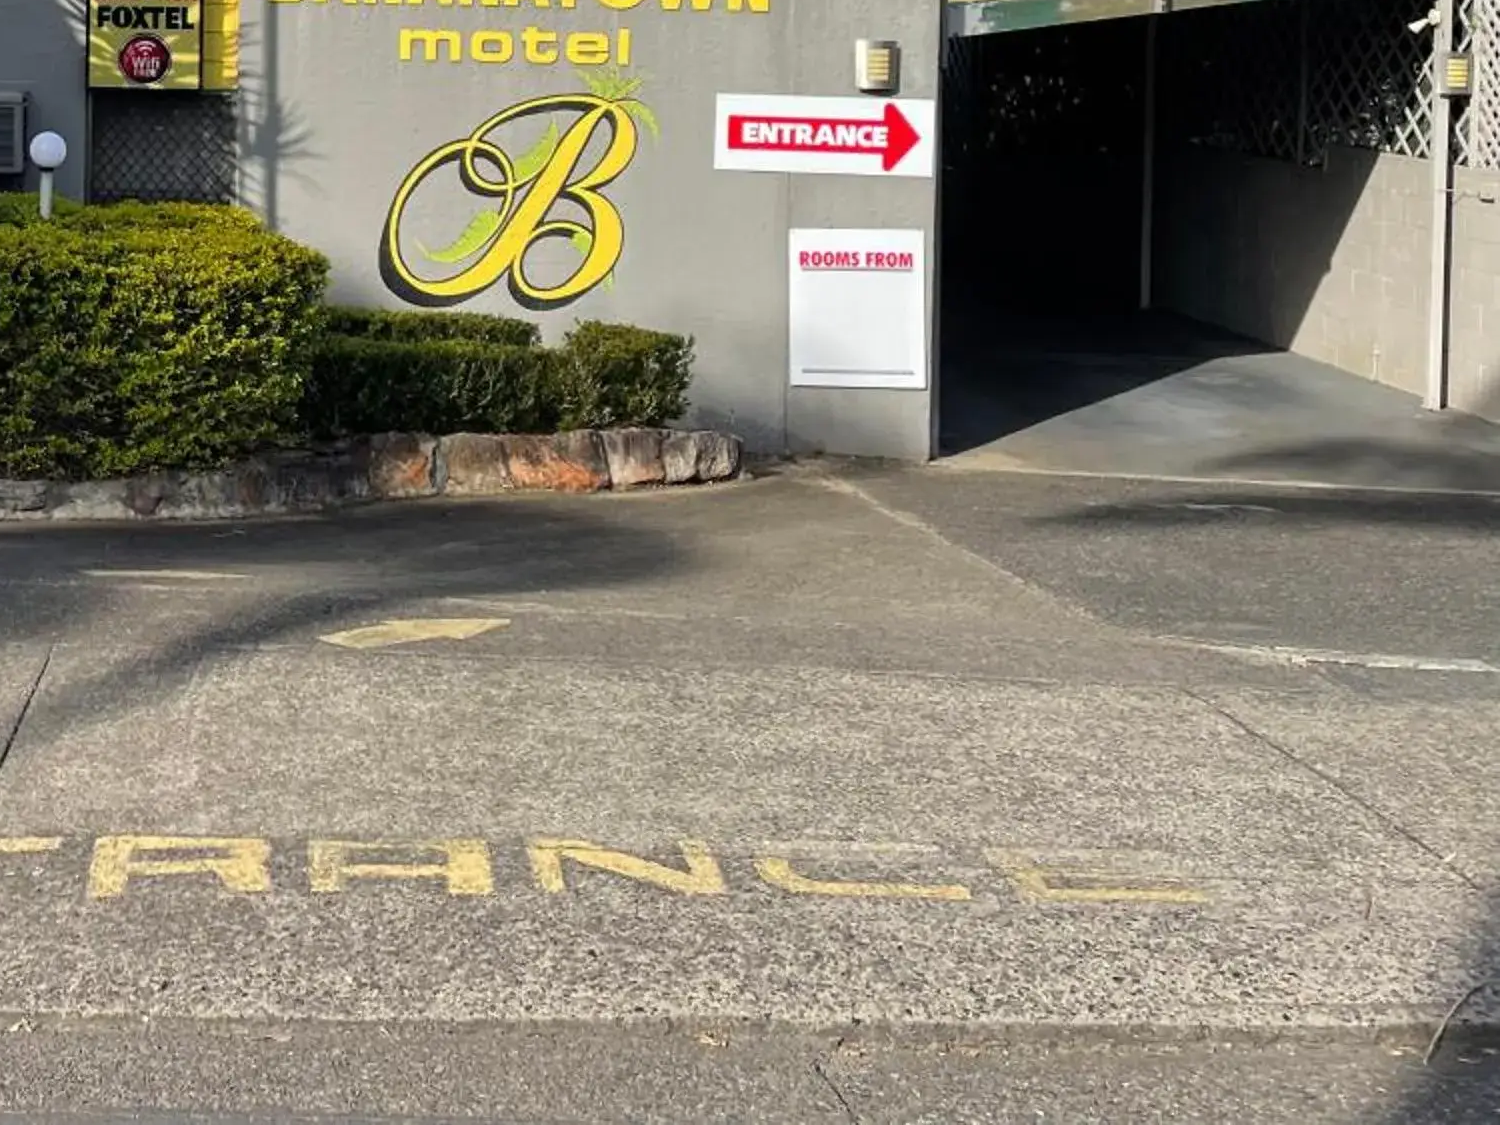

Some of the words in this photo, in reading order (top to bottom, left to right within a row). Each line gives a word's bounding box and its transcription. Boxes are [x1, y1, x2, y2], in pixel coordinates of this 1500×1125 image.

[97, 6, 195, 31] FOXTEL
[398, 27, 632, 67] motel
[740, 122, 890, 148] ENTRANCE
[799, 250, 860, 268] ROOMS
[866, 251, 914, 269] FROM
